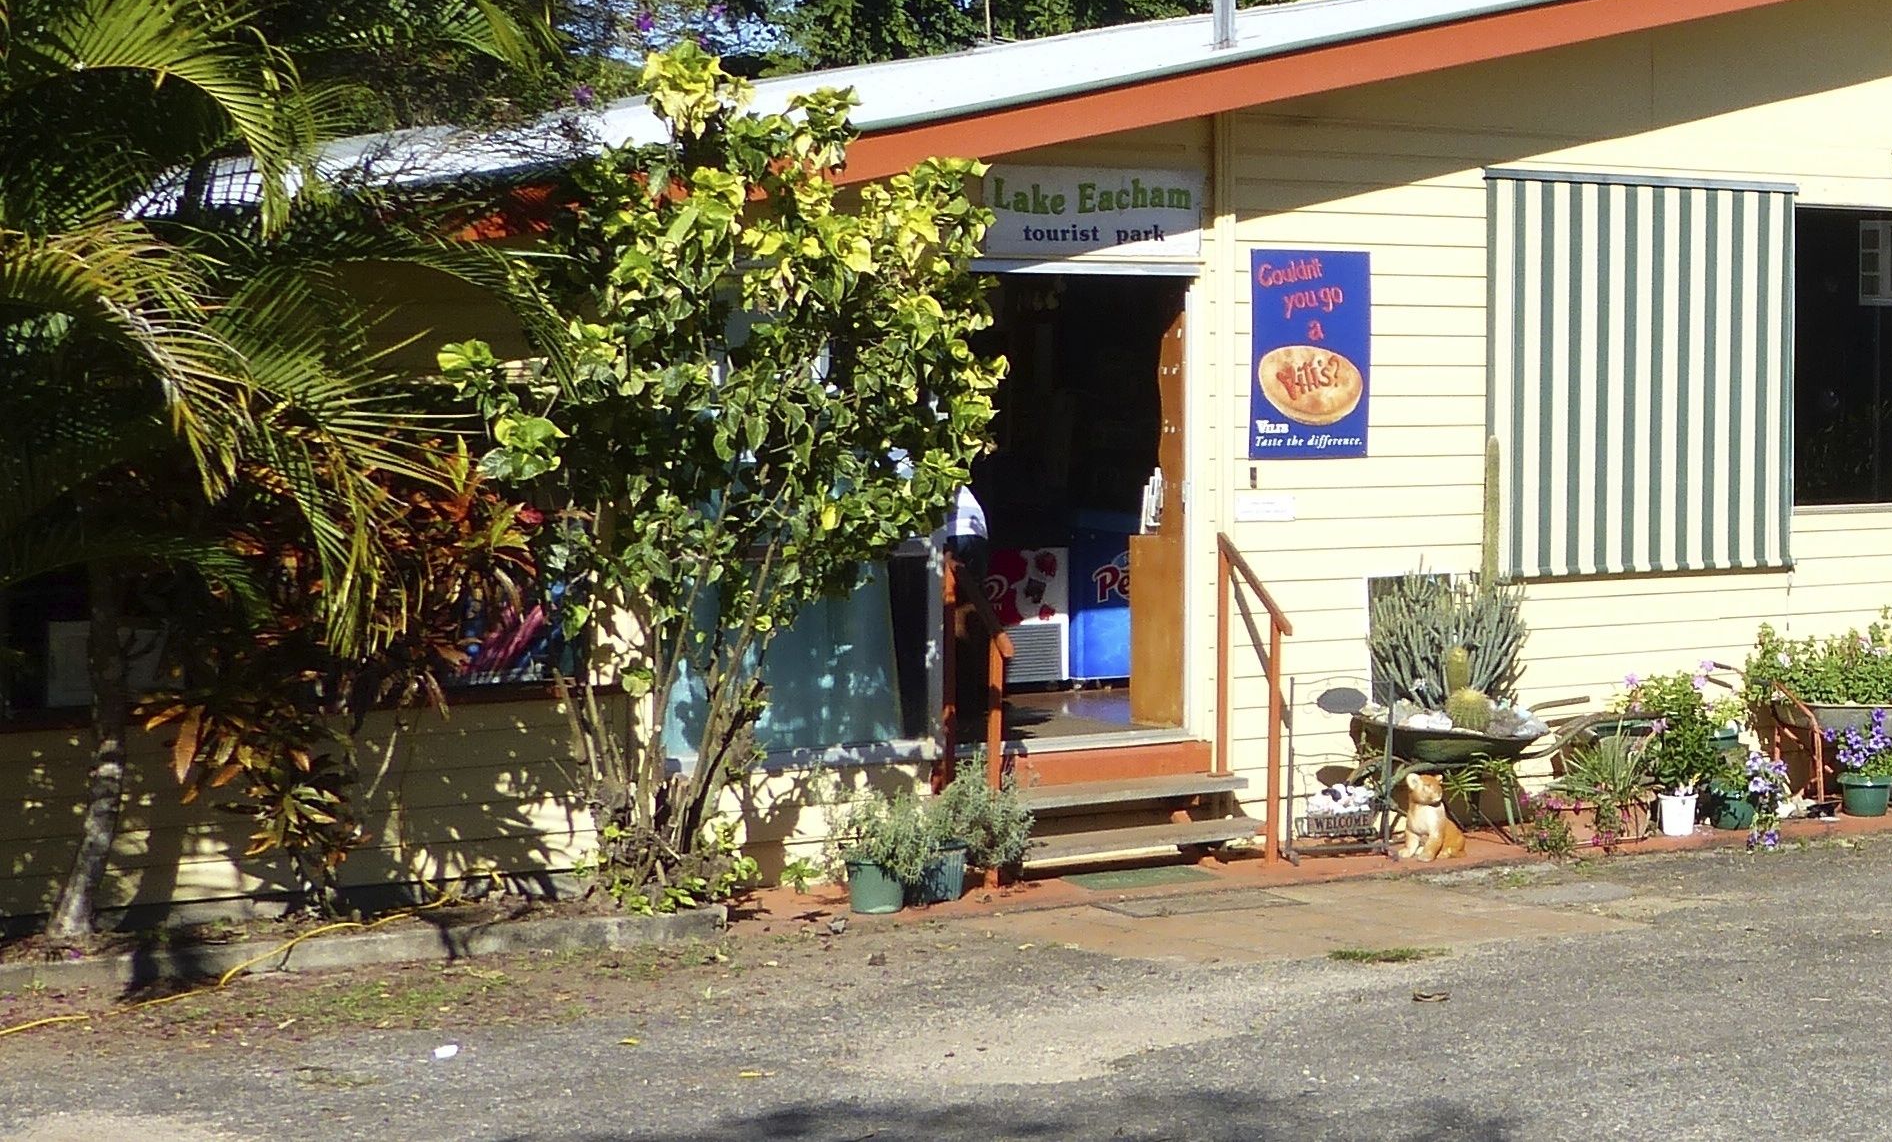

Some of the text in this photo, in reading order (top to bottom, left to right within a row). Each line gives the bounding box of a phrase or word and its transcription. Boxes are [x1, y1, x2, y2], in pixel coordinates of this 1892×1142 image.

[993, 177, 1192, 215] Lake Eacham
[1023, 224, 1165, 245] tourist park
[1283, 286, 1344, 319] you go
[1308, 320, 1324, 340] a
[1255, 435, 1284, 447] Taste
[1286, 435, 1305, 447] the
[1314, 815, 1370, 829] WELCOME
